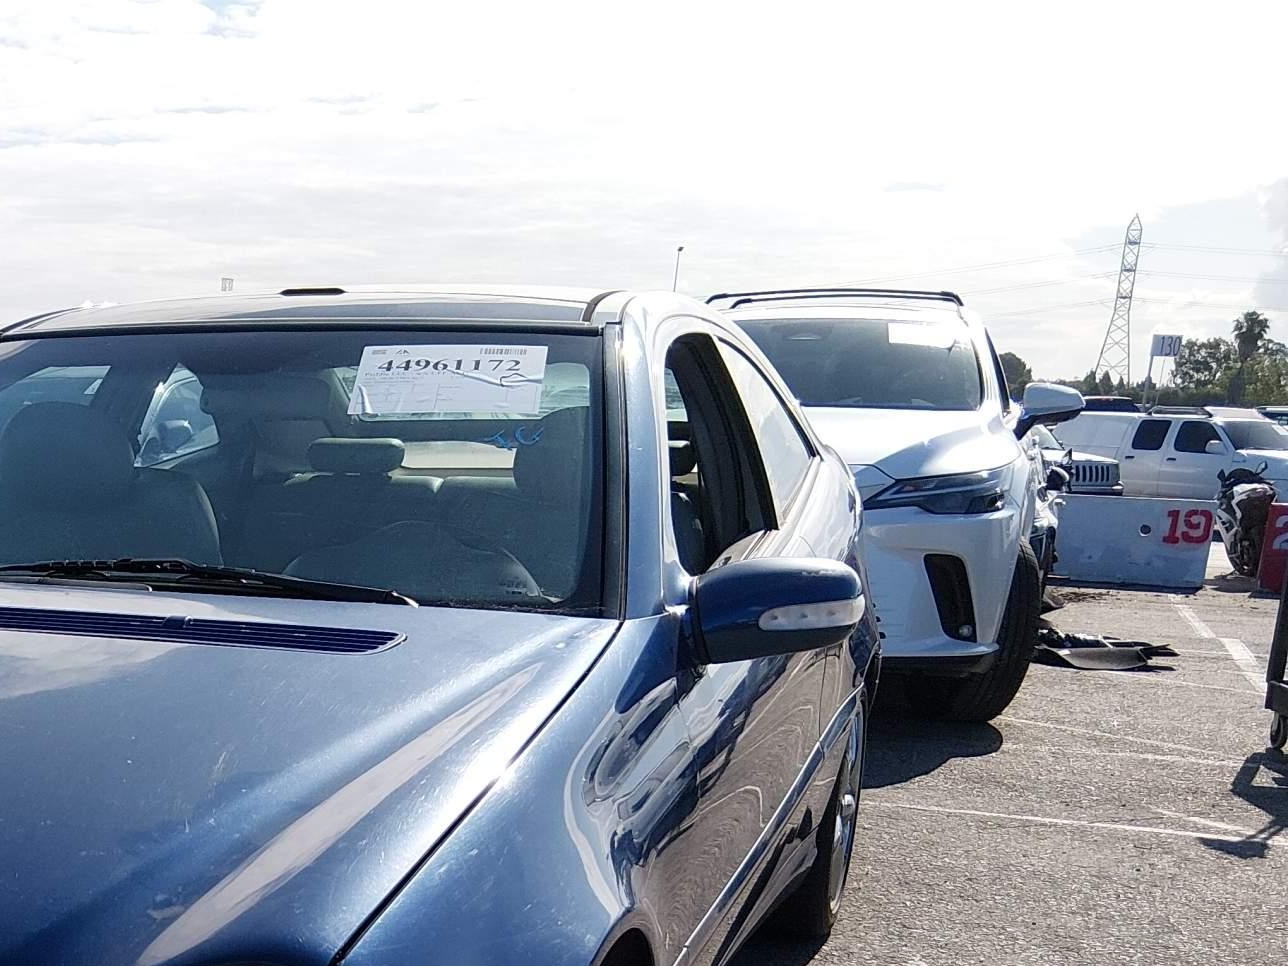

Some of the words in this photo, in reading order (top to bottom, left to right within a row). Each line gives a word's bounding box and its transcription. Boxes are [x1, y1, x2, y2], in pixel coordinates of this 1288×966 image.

[1160, 335, 1182, 356] 130
[378, 358, 521, 372] 44961172
[1162, 509, 1213, 544] 19
